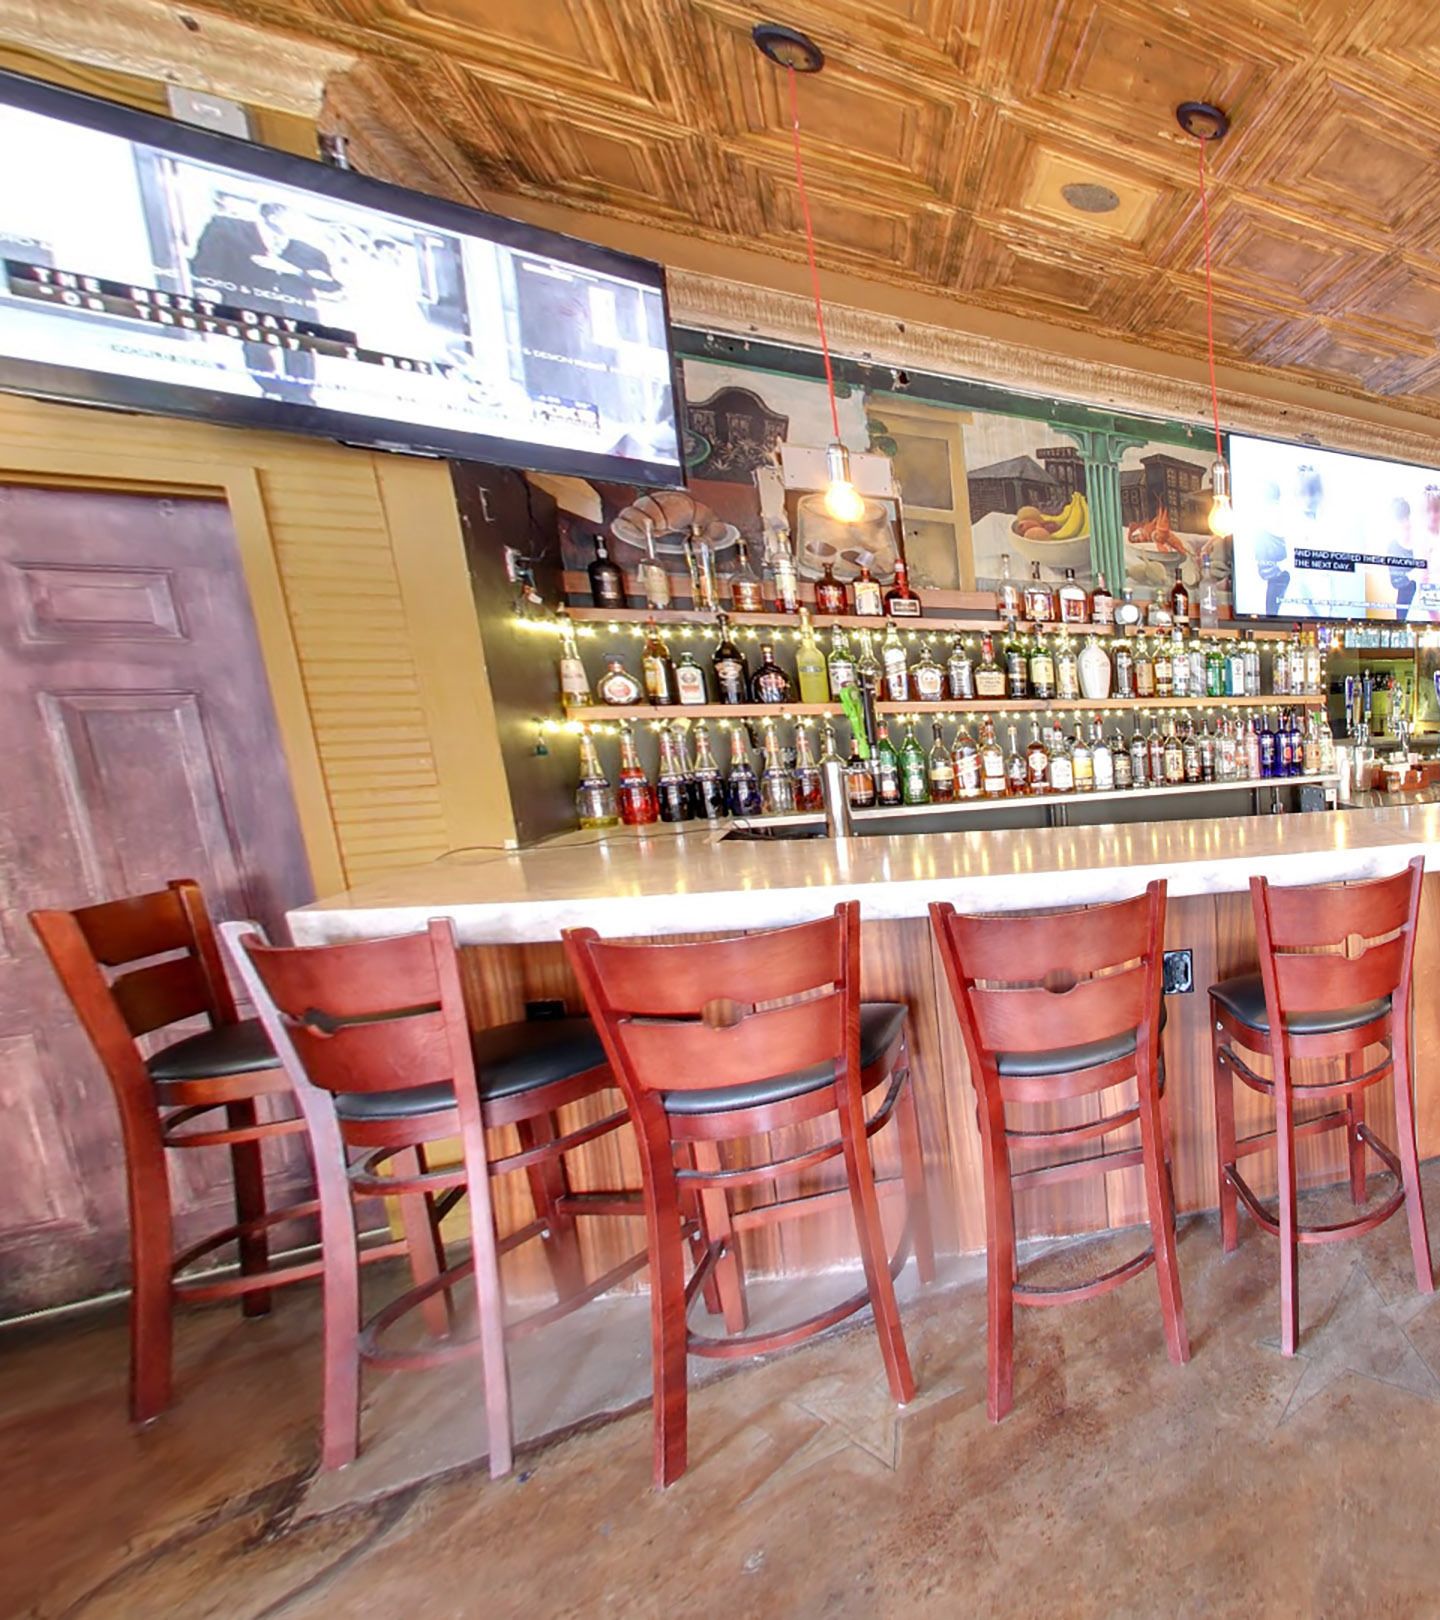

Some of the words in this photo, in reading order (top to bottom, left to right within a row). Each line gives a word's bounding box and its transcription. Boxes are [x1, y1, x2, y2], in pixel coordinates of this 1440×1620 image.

[36, 266, 100, 292] THE
[131, 287, 216, 316] NEXT
[1312, 550, 1330, 560] HAD
[1295, 559, 1311, 568] THE
[1311, 560, 1332, 570] NEXT
